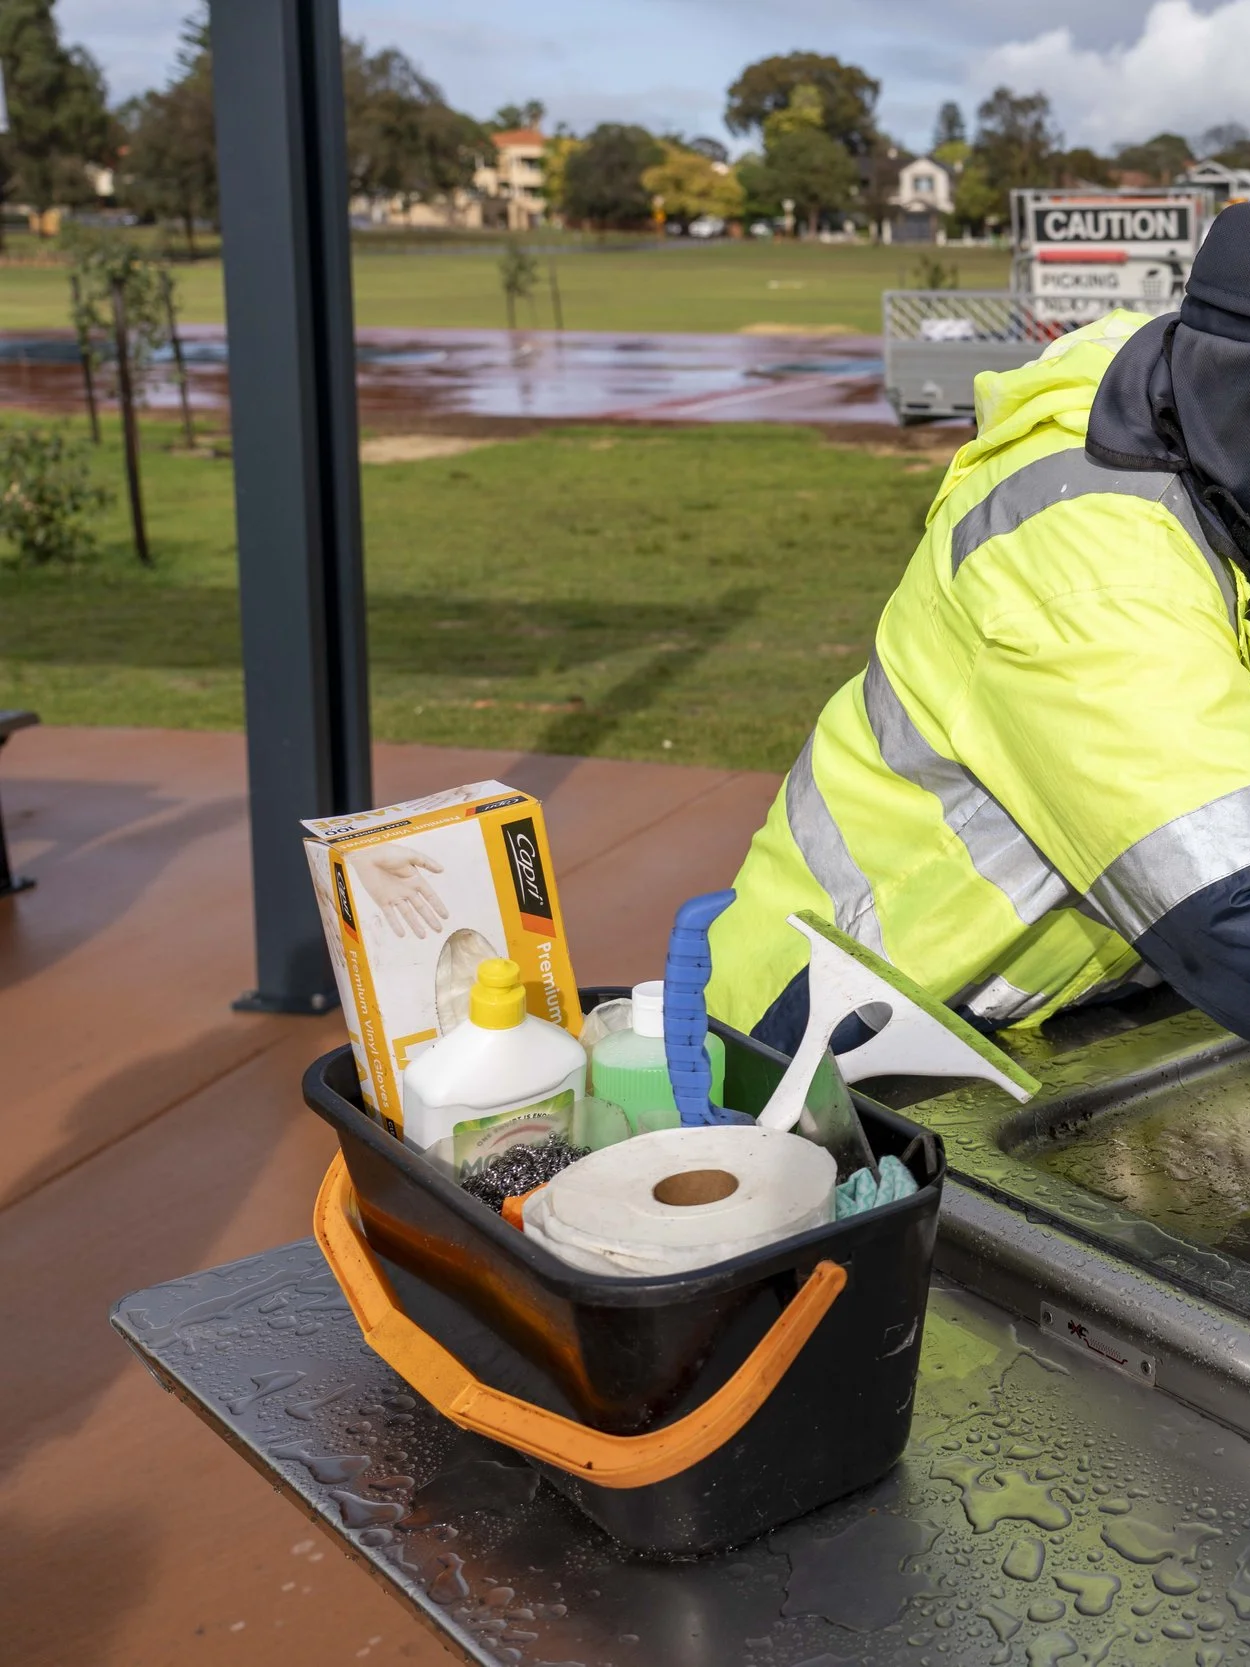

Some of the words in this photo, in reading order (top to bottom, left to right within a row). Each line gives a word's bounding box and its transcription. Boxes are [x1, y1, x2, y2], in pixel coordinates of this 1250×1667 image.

[1044, 210, 1179, 240] CAUTION
[1041, 272, 1119, 289] PICKING
[311, 806, 402, 830] LARGE
[412, 815, 461, 831] Premium
[325, 826, 356, 836] 100
[382, 828, 412, 839] Vinyl
[340, 836, 381, 849] Gloves
[511, 832, 545, 905] Capri
[536, 941, 563, 1024] Premium
[349, 949, 368, 1014] Premium
[364, 1020, 380, 1055] Vinyl
[374, 1059, 389, 1108] Gloves
